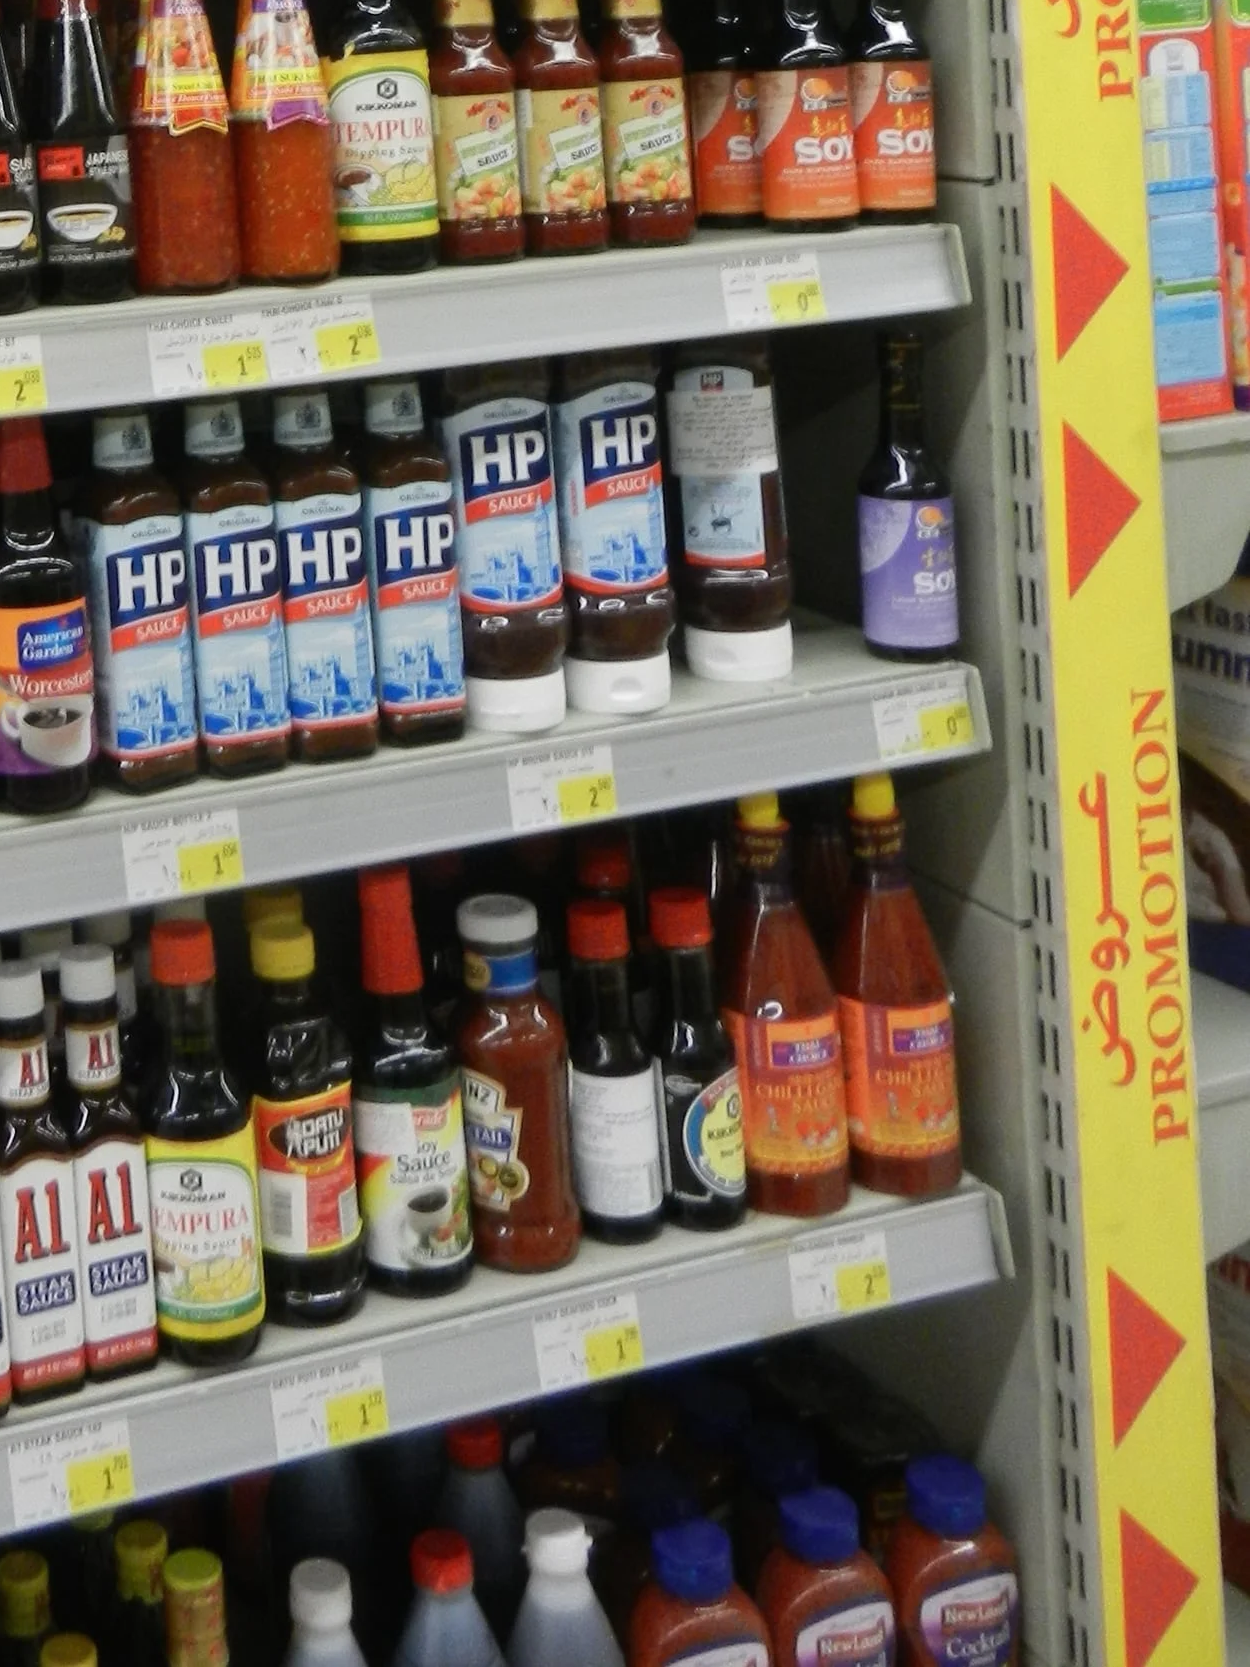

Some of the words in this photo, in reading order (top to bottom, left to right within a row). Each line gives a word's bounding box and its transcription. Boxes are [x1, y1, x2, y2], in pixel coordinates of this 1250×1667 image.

[591, 414, 658, 469] HP
[469, 430, 547, 485] HP
[606, 476, 653, 497] SAUCE
[487, 492, 536, 514] SAUCE
[383, 513, 454, 572] HP
[202, 539, 278, 600] HP
[286, 527, 363, 587] HP
[115, 549, 186, 612] HP
[401, 578, 450, 600] SAUCE
[221, 606, 269, 628] SAUCE
[305, 594, 355, 616] SAUCE
[20, 625, 84, 648] American
[135, 616, 180, 640] SAUCE
[21, 641, 75, 661] Garden
[1130, 687, 1190, 1149] PROMOTION
[396, 1148, 451, 1175] Sauce
[150, 1204, 250, 1234] EMPURA
[90, 1256, 144, 1283] STEAK
[91, 1266, 148, 1296] SAUCE
[17, 1273, 71, 1302] STEAK
[18, 1286, 75, 1314] SAUCE
